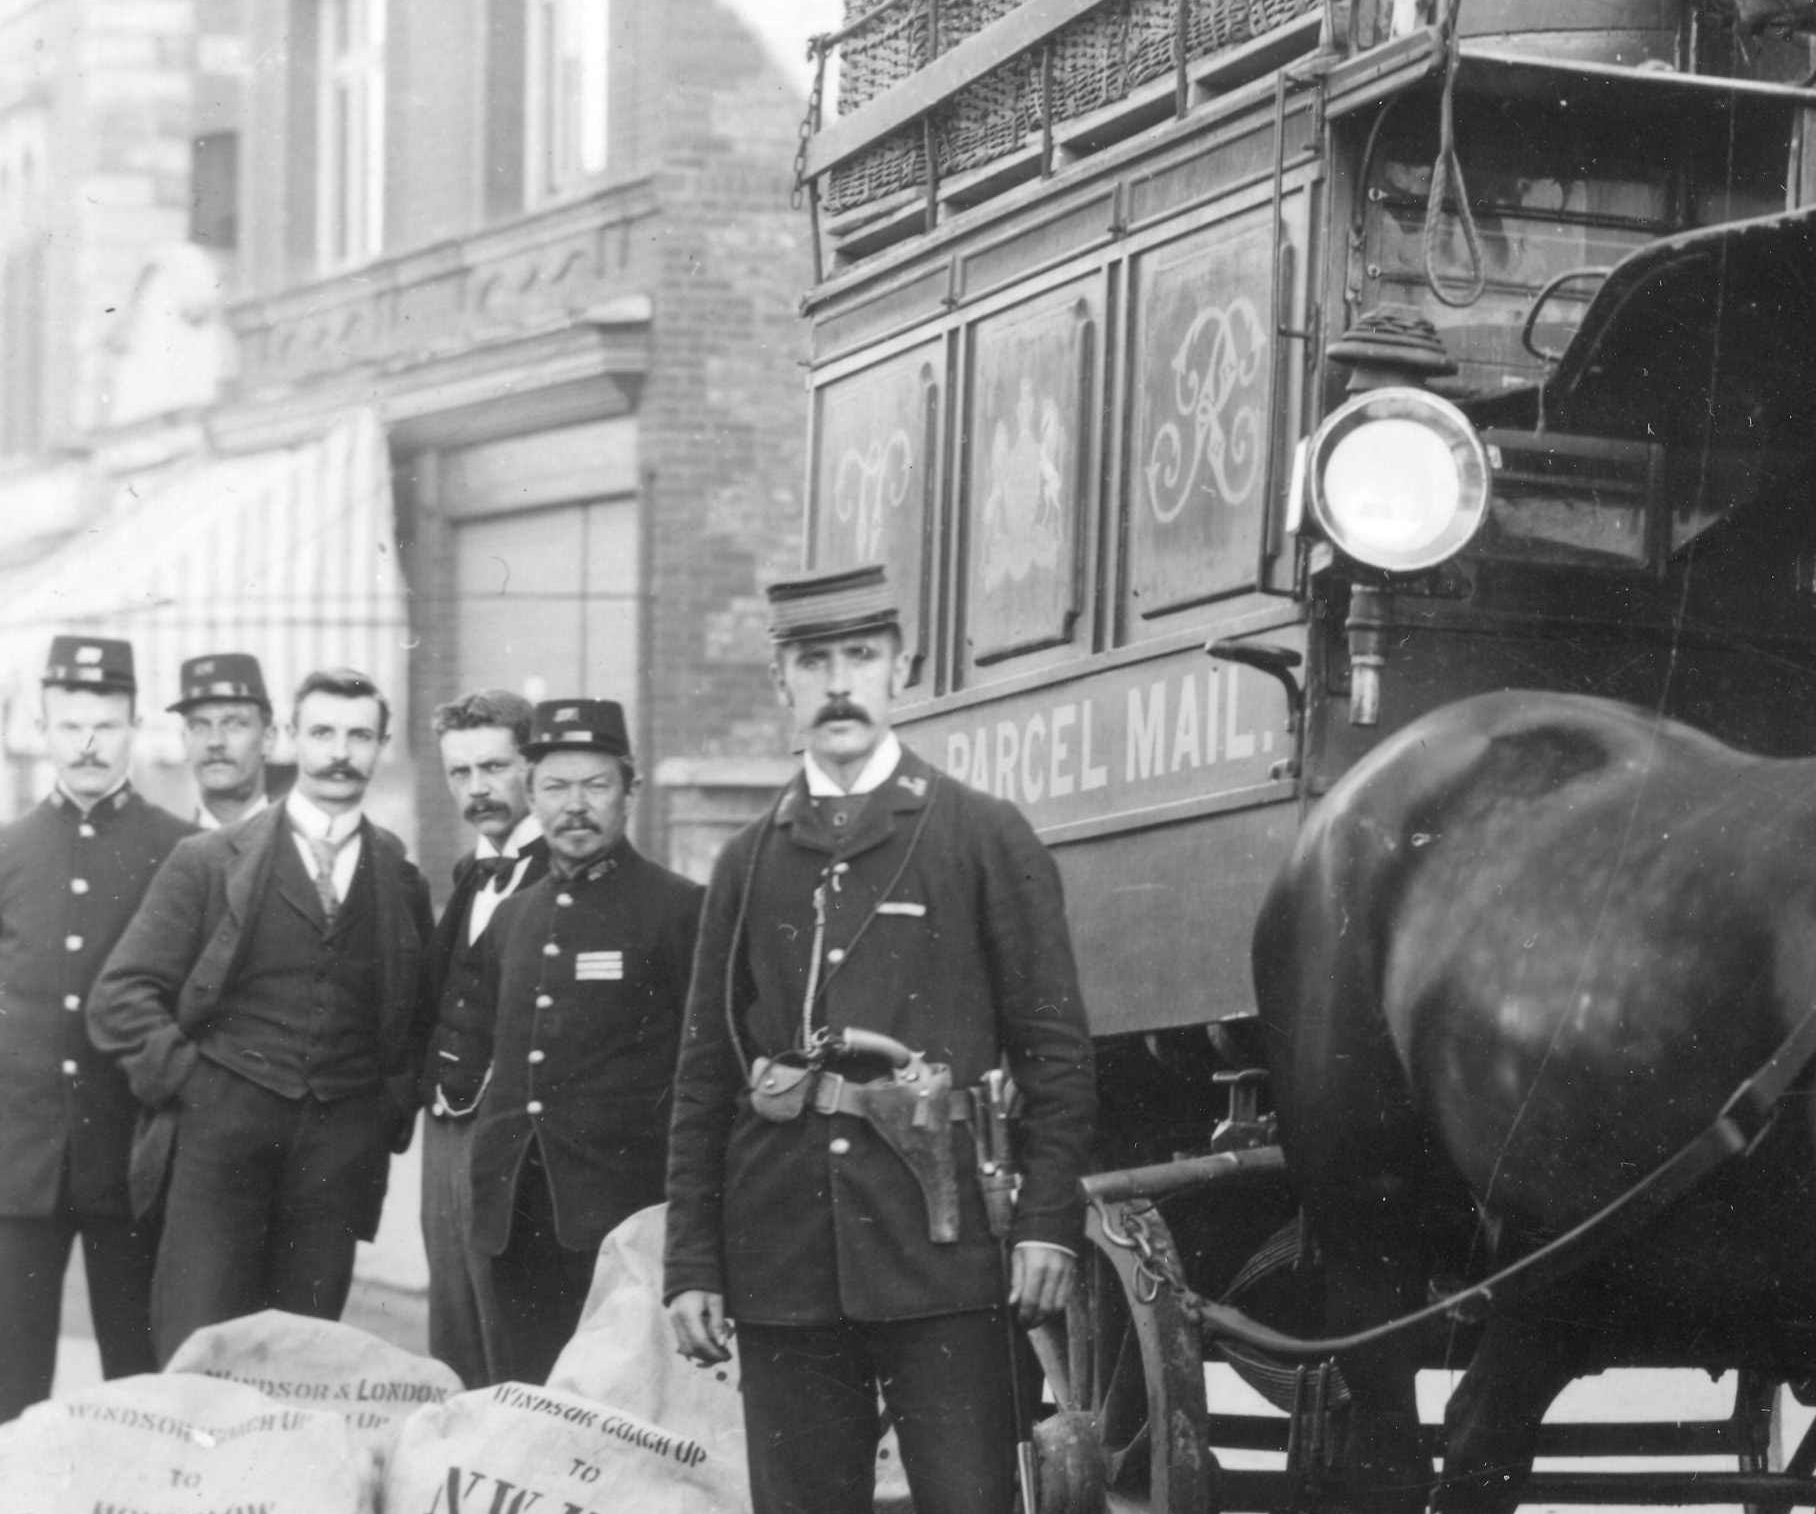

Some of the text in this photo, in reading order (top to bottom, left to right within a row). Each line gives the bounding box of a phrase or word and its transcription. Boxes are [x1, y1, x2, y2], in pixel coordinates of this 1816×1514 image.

[947, 664, 1273, 806] PARCEL MAIL.
[356, 1378, 448, 1404] LONDON
[200, 1413, 275, 1446] OACH
[493, 1384, 599, 1428] WINDSOR
[601, 1416, 673, 1457] COACH
[170, 1468, 202, 1489] TO
[568, 1457, 601, 1484] TO
